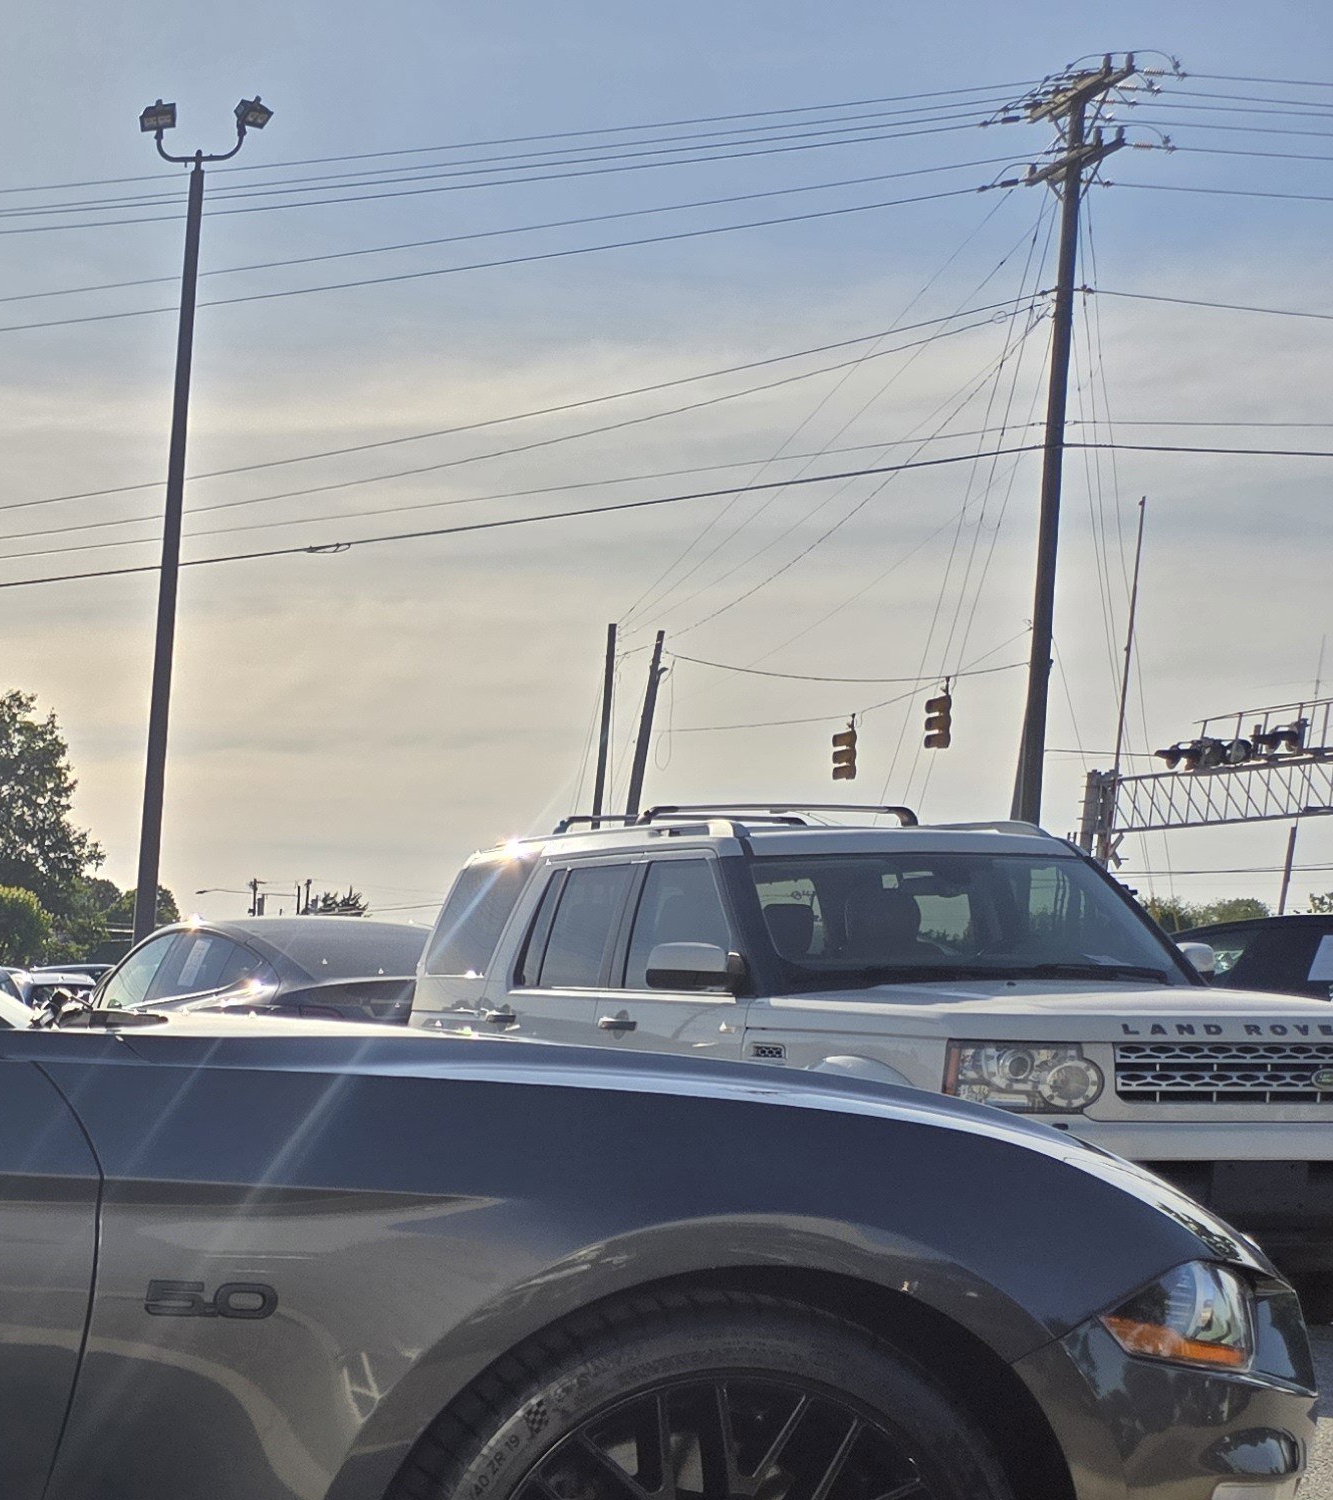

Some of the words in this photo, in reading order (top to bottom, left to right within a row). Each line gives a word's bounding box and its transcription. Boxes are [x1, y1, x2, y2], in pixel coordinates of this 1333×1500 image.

[1120, 1023, 1223, 1036] LAND
[144, 1280, 278, 1320] 5.0
[487, 1452, 507, 1475] ZR
[503, 1434, 521, 1452] 19
